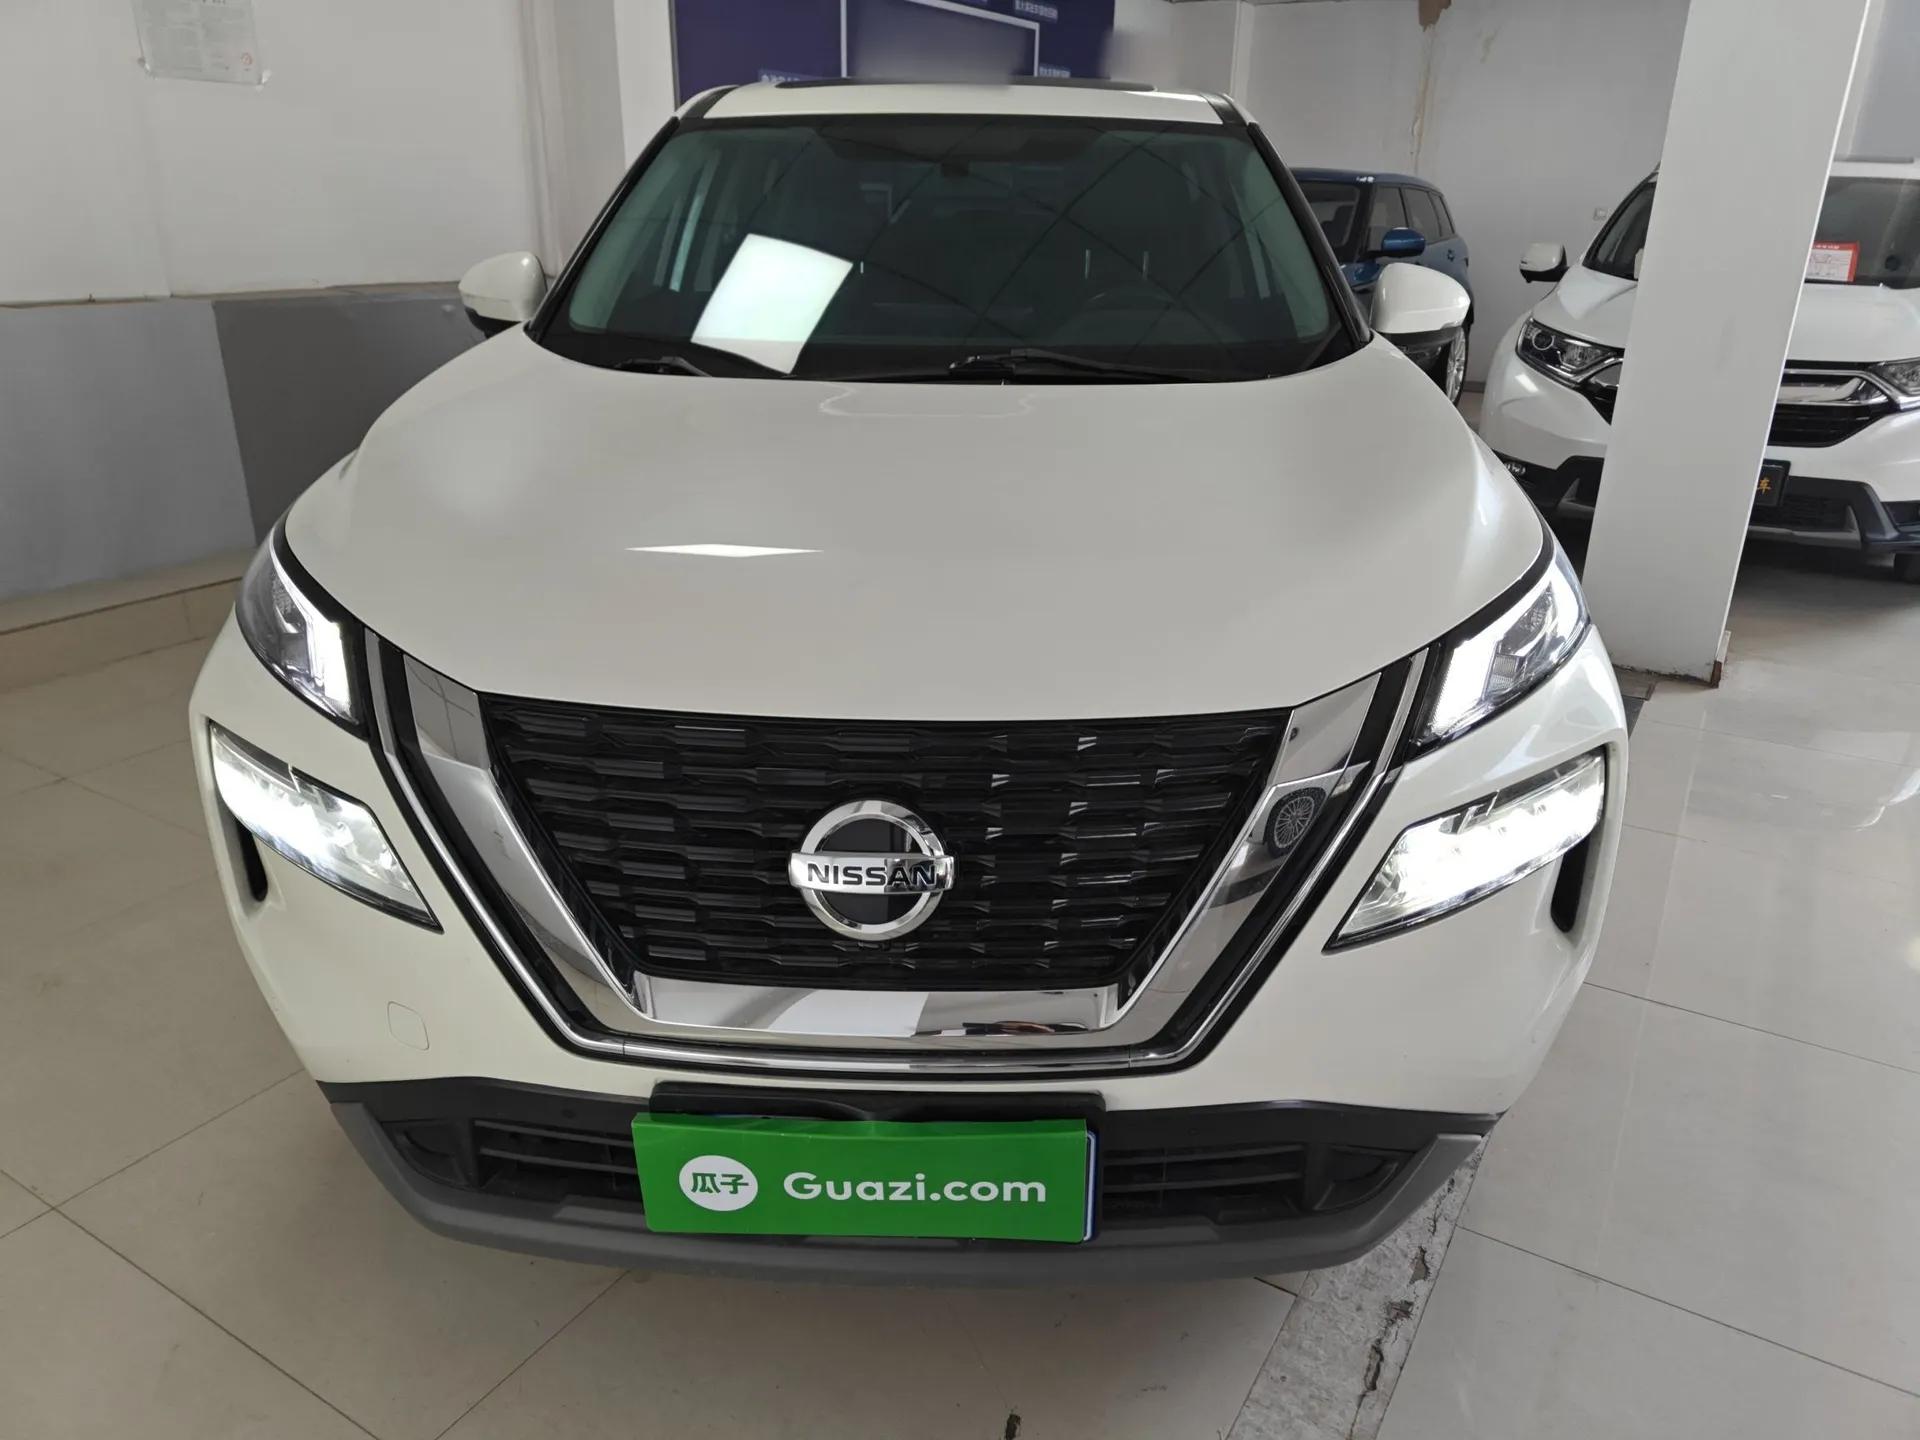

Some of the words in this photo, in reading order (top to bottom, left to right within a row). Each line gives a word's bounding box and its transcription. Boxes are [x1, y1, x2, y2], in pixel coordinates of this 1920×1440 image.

[807, 862, 936, 887] NISSAN
[691, 1172, 749, 1194] 瓜子
[783, 1171, 1047, 1202] Guazi.com
